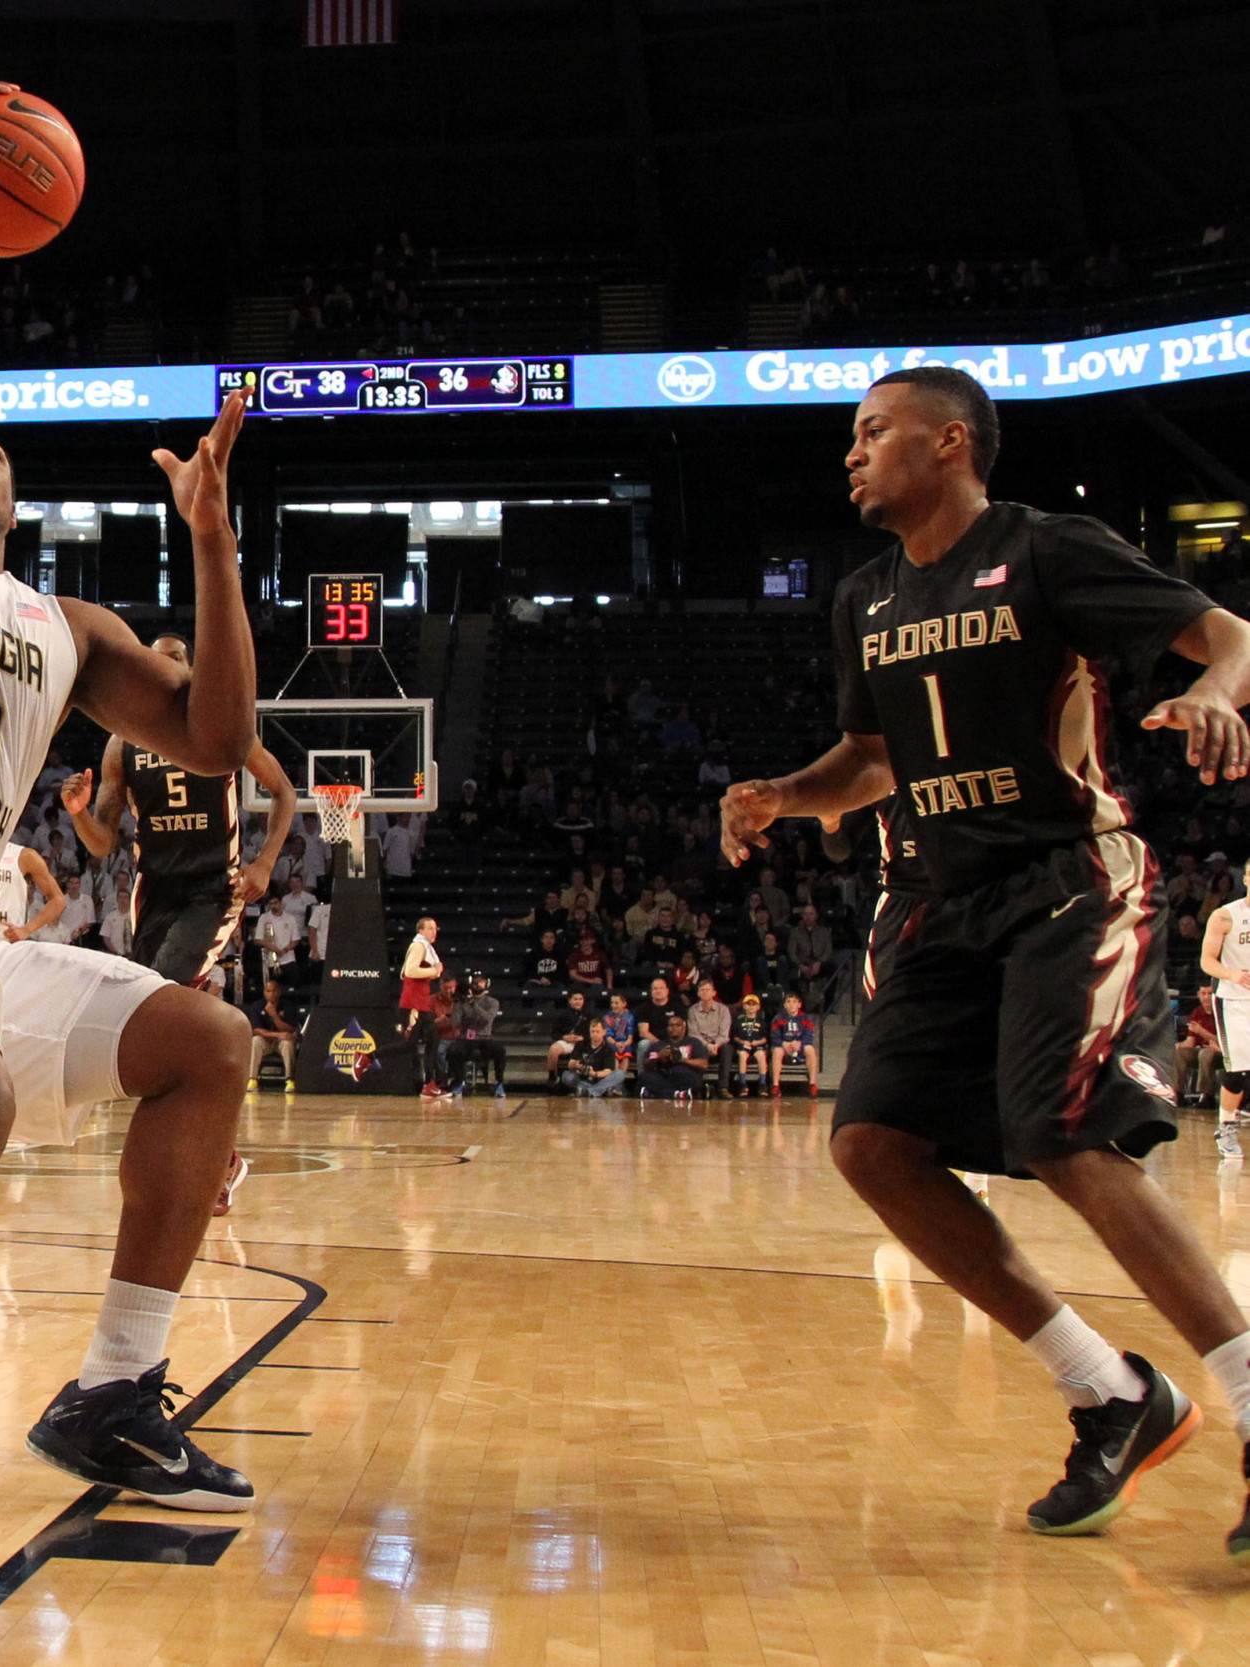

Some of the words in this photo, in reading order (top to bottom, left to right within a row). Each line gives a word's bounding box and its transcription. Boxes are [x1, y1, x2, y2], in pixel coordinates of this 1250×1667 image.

[396, 346, 415, 356] 214
[219, 372, 242, 387] FLS
[379, 367, 405, 380] 2ND
[438, 367, 469, 392] 36
[527, 364, 551, 380] FLS
[745, 351, 890, 392] Great
[901, 347, 1027, 387] fod.
[1041, 343, 1150, 386] Low
[266, 370, 311, 399] GT
[317, 370, 346, 395] 38
[532, 387, 553, 400] TOL
[554, 386, 564, 400] 3
[364, 385, 421, 408] 13:35
[325, 603, 369, 640] 33
[861, 604, 1023, 672] FLORIDA
[920, 672, 951, 759] 1
[165, 771, 188, 808] 5
[908, 766, 1022, 817] STATE
[149, 813, 209, 832] STATE
[332, 1039, 373, 1053] Superior
